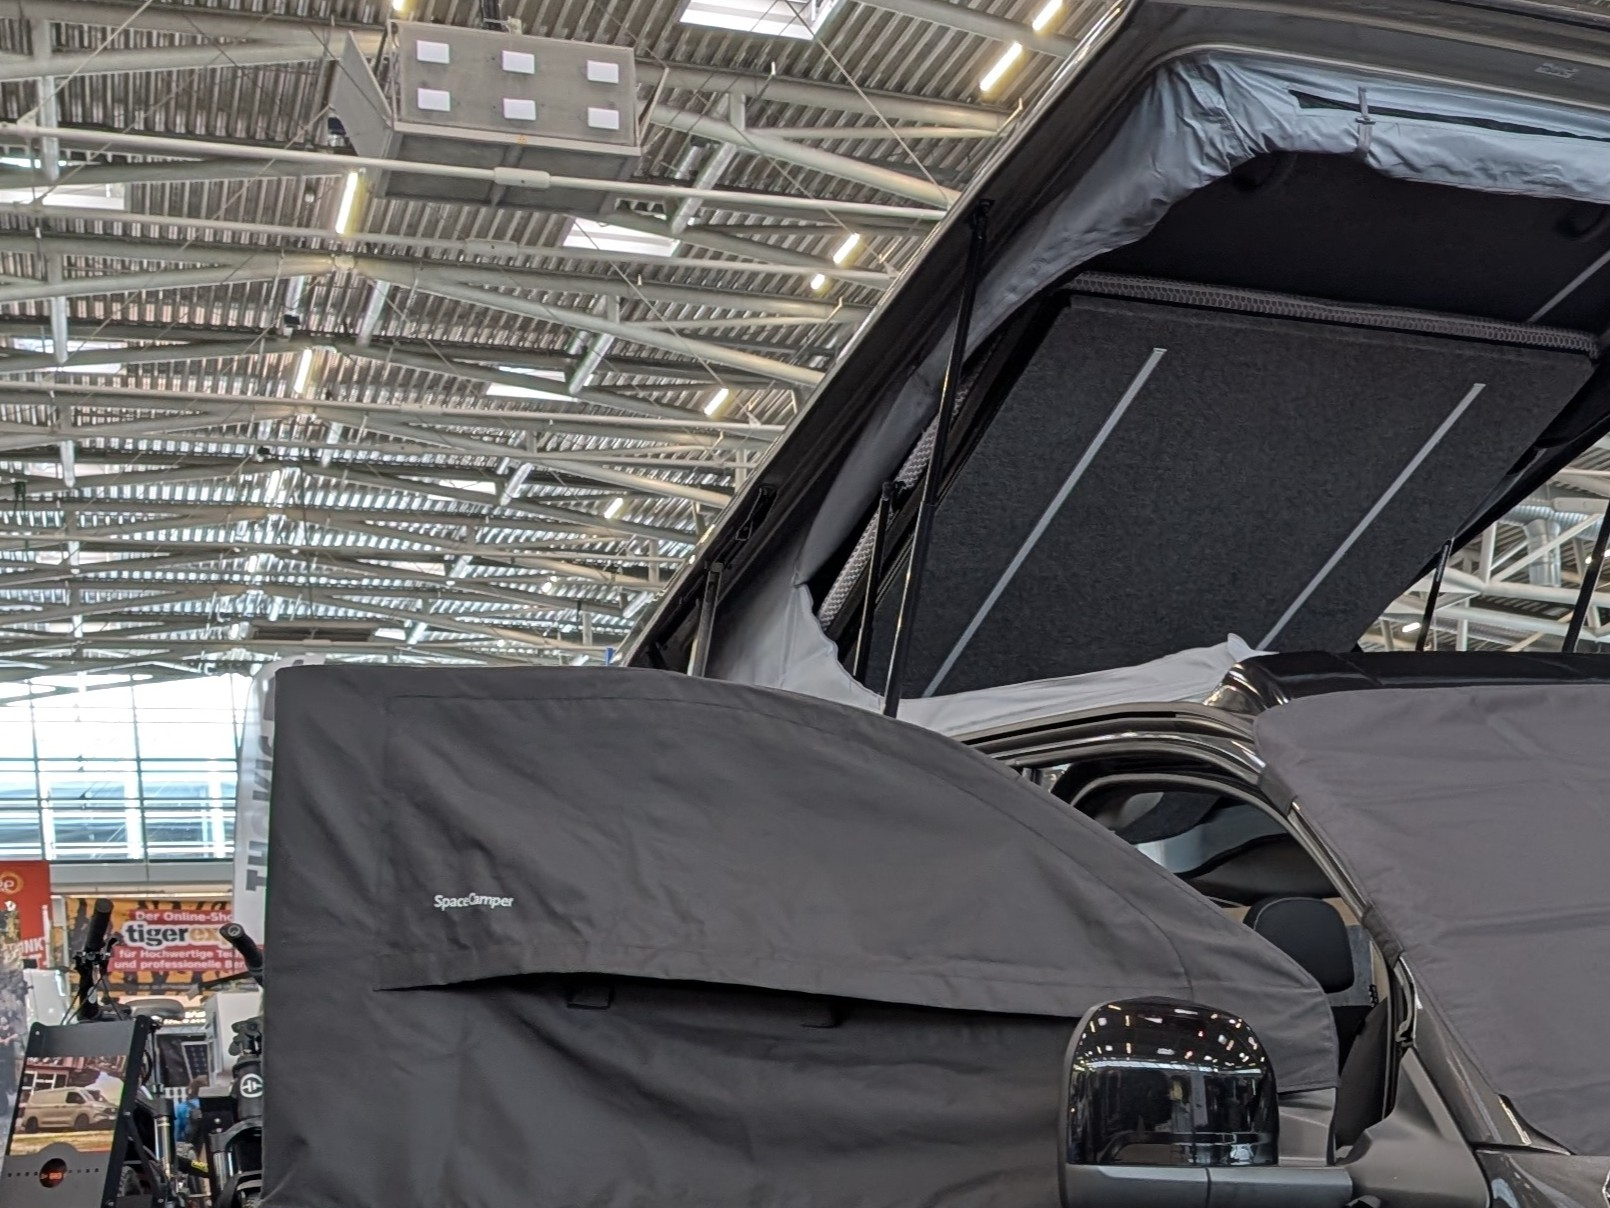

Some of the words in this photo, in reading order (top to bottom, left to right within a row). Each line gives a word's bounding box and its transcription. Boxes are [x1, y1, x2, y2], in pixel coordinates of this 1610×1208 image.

[433, 892, 514, 911] SpaceCamper
[135, 912, 160, 921] Der
[164, 911, 233, 922] Online-Sho
[119, 950, 137, 959] für
[140, 950, 213, 960] Hochwertige
[114, 960, 137, 969] und
[140, 960, 221, 971] professionelle
